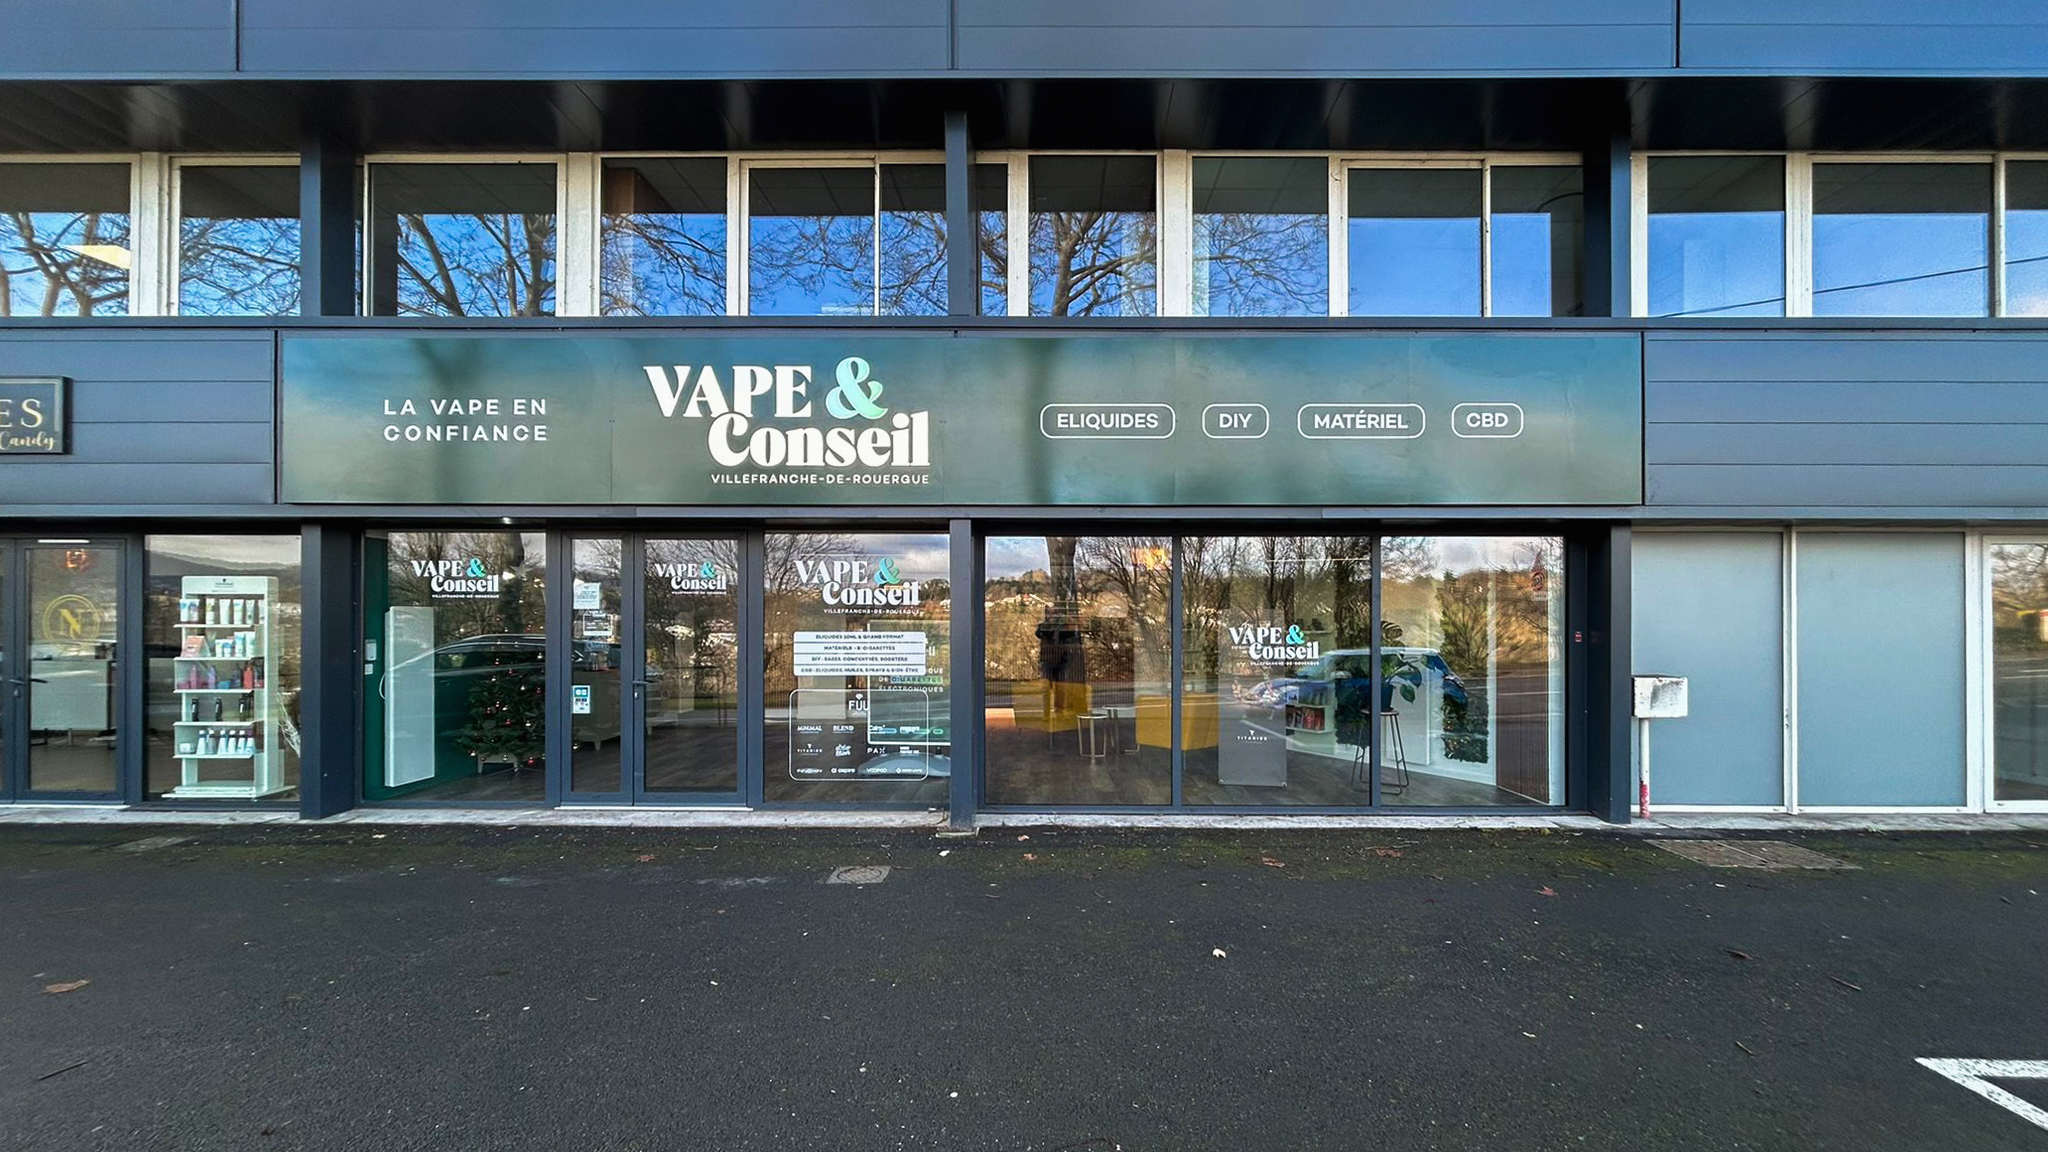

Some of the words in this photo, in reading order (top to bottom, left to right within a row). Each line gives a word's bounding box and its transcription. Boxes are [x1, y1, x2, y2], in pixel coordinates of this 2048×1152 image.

[643, 365, 812, 418] VAPE
[825, 356, 889, 420] &
[383, 399, 417, 416] LA
[430, 399, 501, 416] VAPE
[512, 399, 547, 416] EN
[1057, 413, 1159, 430] ELIQUIDES
[1219, 413, 1252, 428] DIY
[1314, 409, 1409, 429] MATÉRIEL
[1465, 412, 1509, 428] CBD
[383, 424, 548, 442] CONFIANCE
[708, 410, 931, 467] Conseil
[711, 473, 930, 485] VILLEFRANCHE-DE-ROUERGUE
[411, 560, 463, 577] VAPE
[466, 557, 486, 578] &
[654, 563, 698, 578] VAPE
[700, 561, 716, 579] &
[794, 560, 868, 584] VAPE
[873, 557, 901, 585] &
[430, 574, 499, 592] Conseil
[670, 574, 727, 590] Conseil
[822, 580, 921, 606] Conseil
[1228, 627, 1283, 645] VAPE
[1285, 624, 1305, 645] &
[1248, 641, 1320, 660] Conseil
